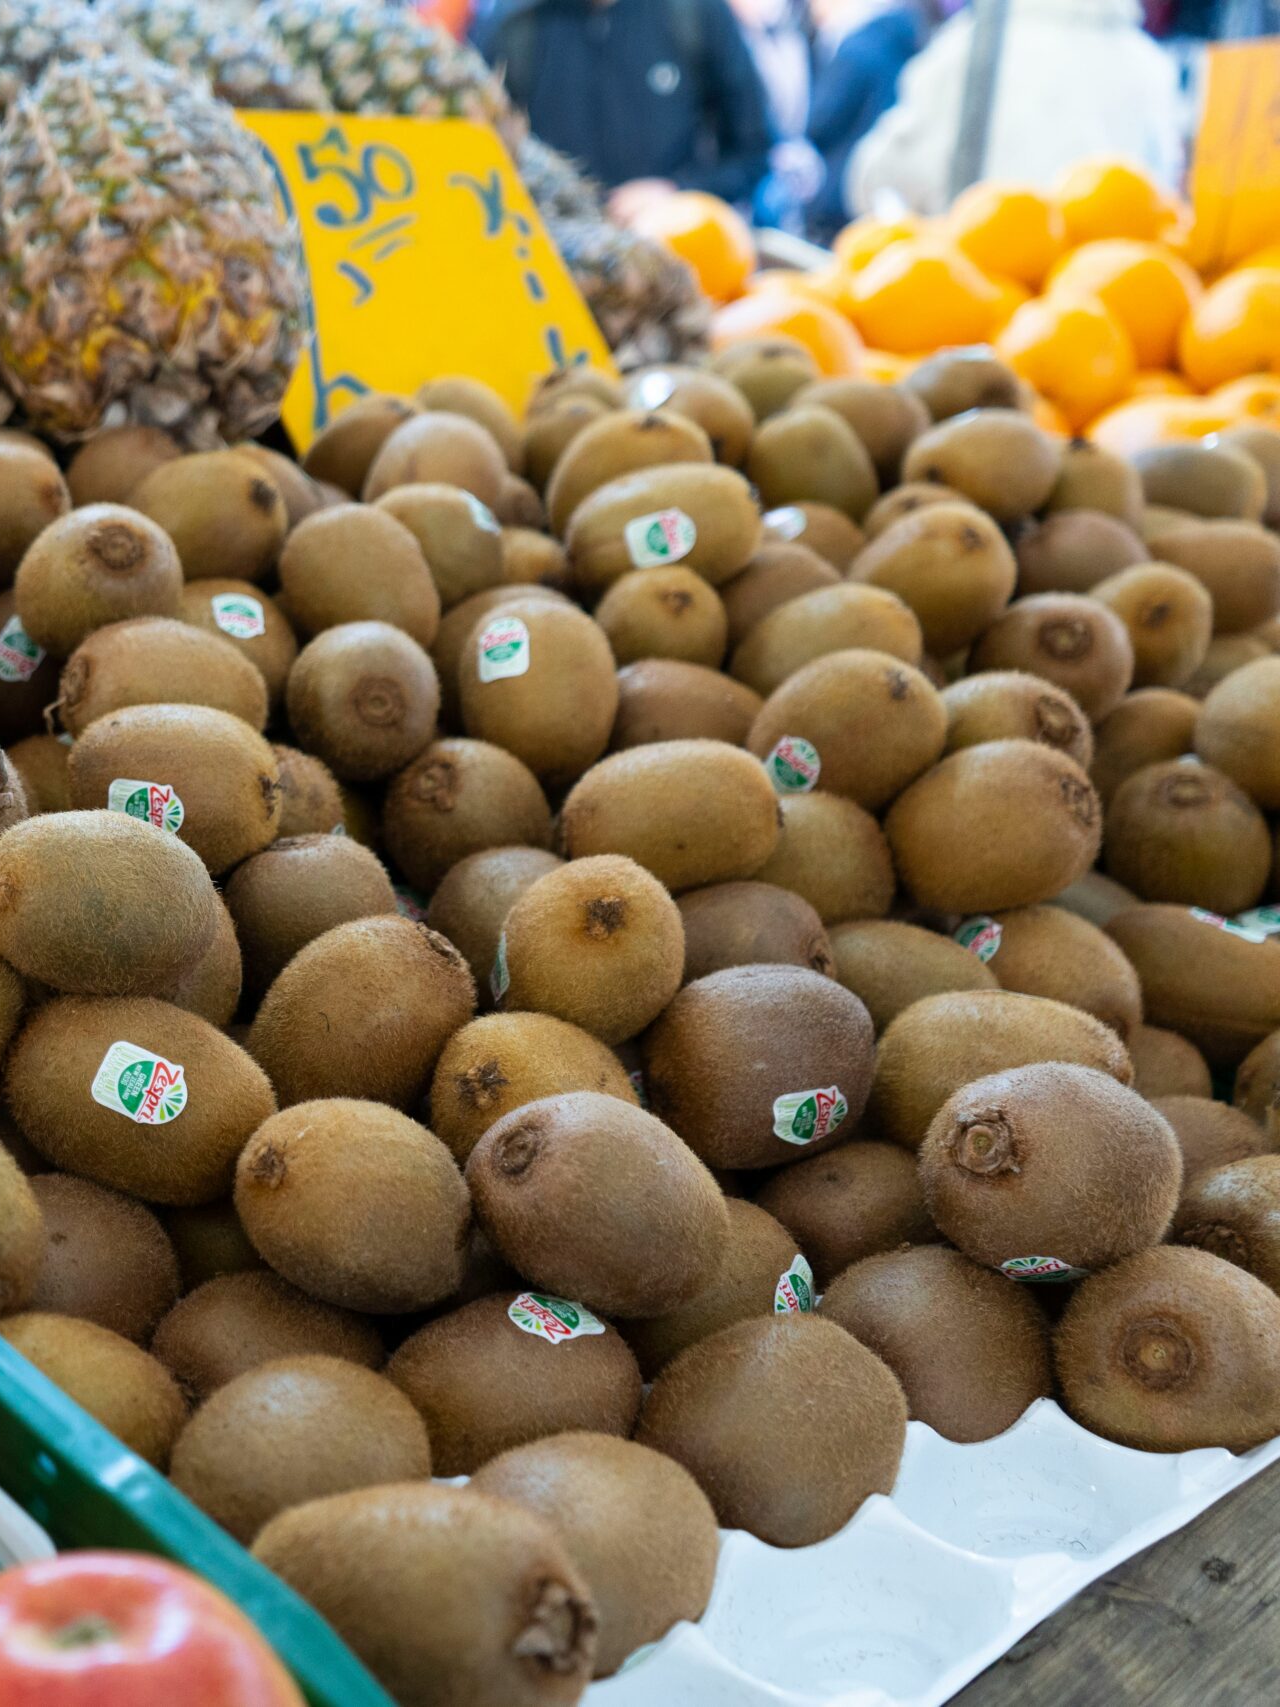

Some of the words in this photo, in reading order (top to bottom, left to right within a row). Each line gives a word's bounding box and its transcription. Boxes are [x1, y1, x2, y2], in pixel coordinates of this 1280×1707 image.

[149, 786, 170, 829] Zespr
[121, 1075, 137, 1100] ZEALAND
[129, 1072, 147, 1098] GREEN
[132, 1063, 142, 1077] NEW
[136, 1061, 181, 1122] Zespri
[813, 1089, 837, 1141] Zespri
[515, 1297, 573, 1341] Zespri
